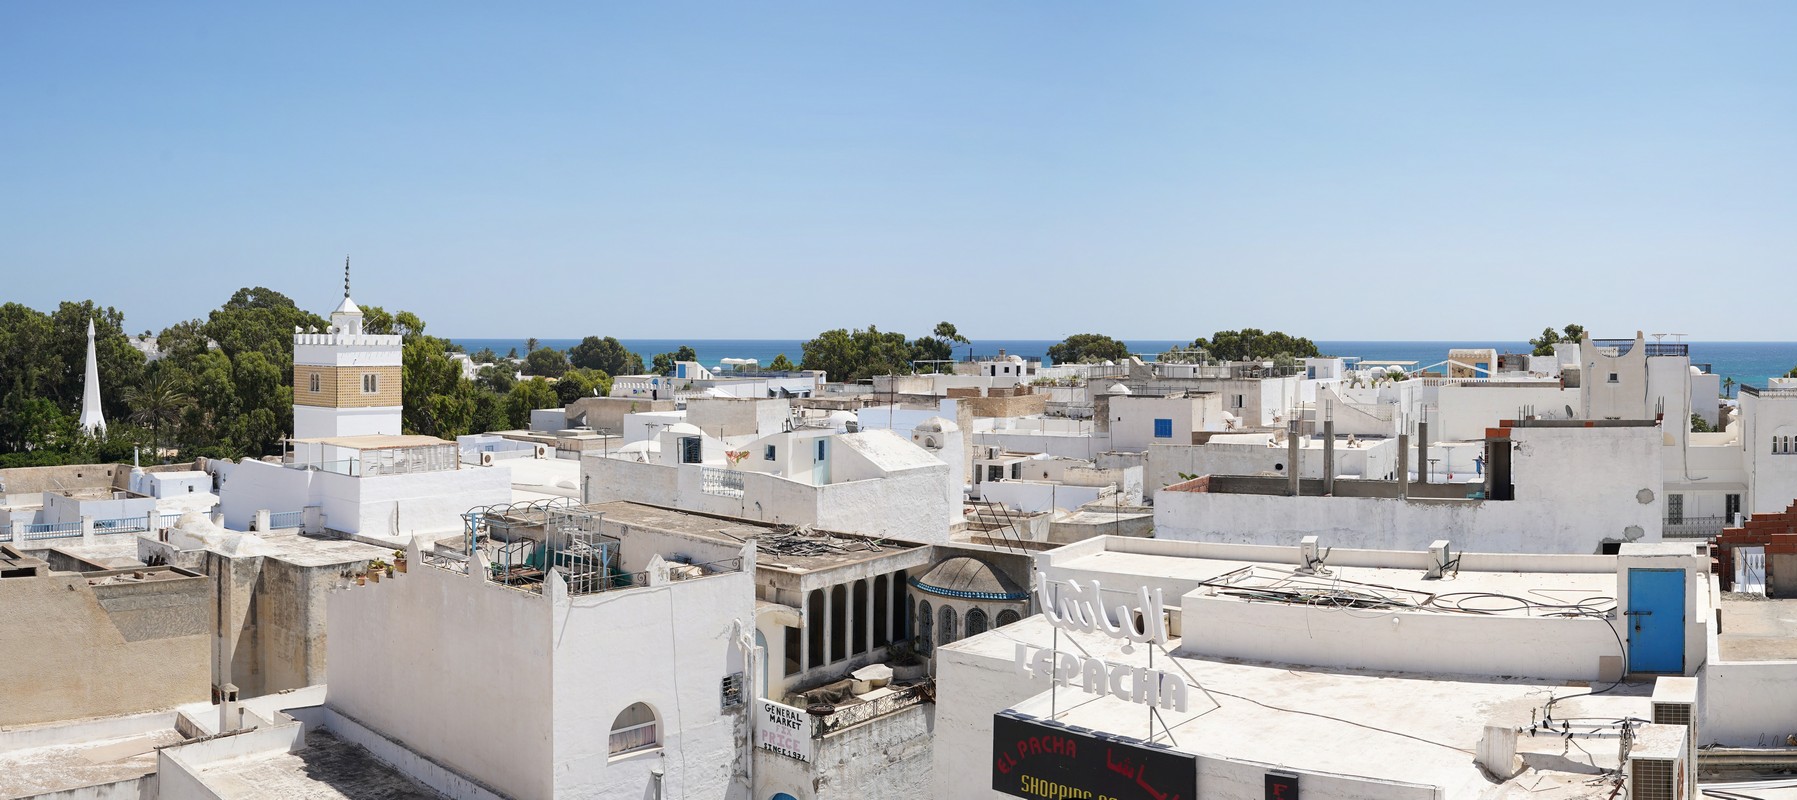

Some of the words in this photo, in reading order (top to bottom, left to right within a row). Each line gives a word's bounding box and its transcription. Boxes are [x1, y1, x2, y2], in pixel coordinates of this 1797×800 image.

[764, 703, 803, 722] GENERAL
[769, 714, 801, 730] MARKET
[762, 729, 801, 752] PRICE
[997, 751, 1018, 774] EL
[1017, 735, 1078, 760] PACHA
